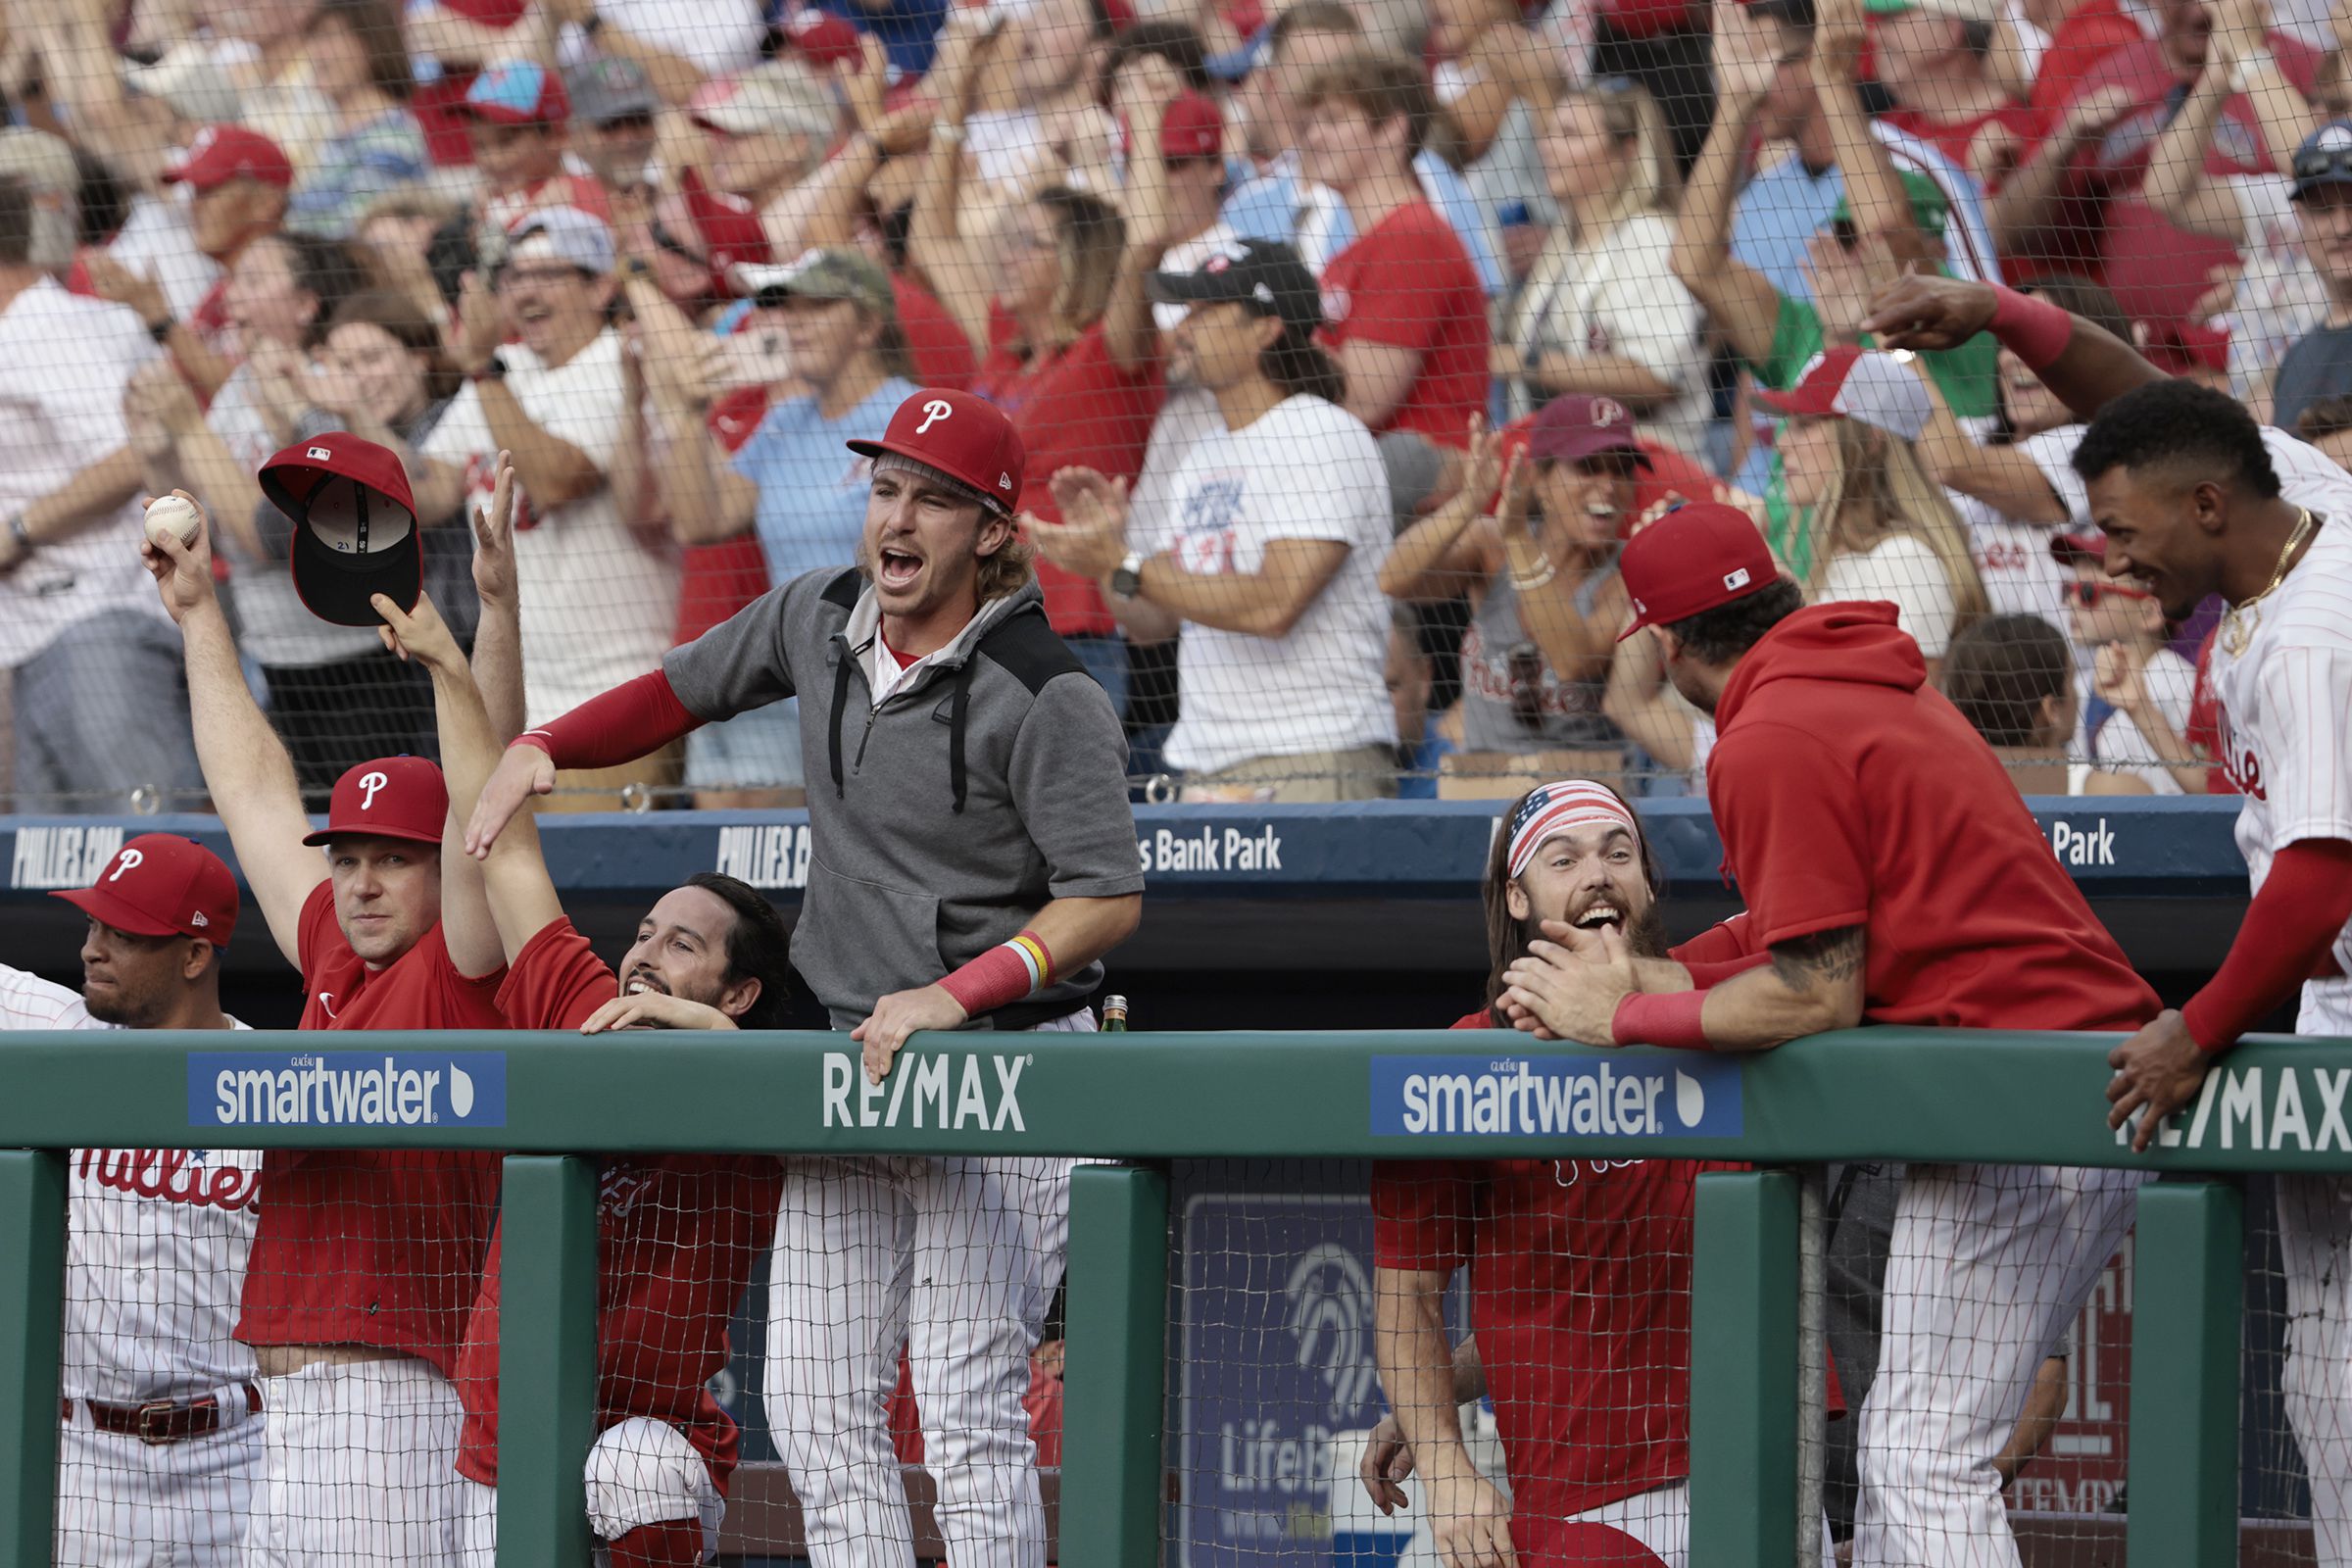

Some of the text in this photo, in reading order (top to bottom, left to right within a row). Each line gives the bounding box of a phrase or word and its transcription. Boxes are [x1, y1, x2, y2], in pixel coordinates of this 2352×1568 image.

[916, 400, 953, 434] P
[359, 771, 388, 810] P
[109, 848, 143, 882] P
[1155, 825, 1219, 871] Bank
[1224, 824, 1282, 871] Park
[2053, 818, 2115, 865] Park
[216, 1056, 440, 1124] smartwater
[823, 1053, 1026, 1132] RE/MAX
[1403, 1061, 1664, 1135] smartwater
[2115, 1066, 2352, 1152] /MAX
[2009, 1478, 2128, 1513] TEMP
